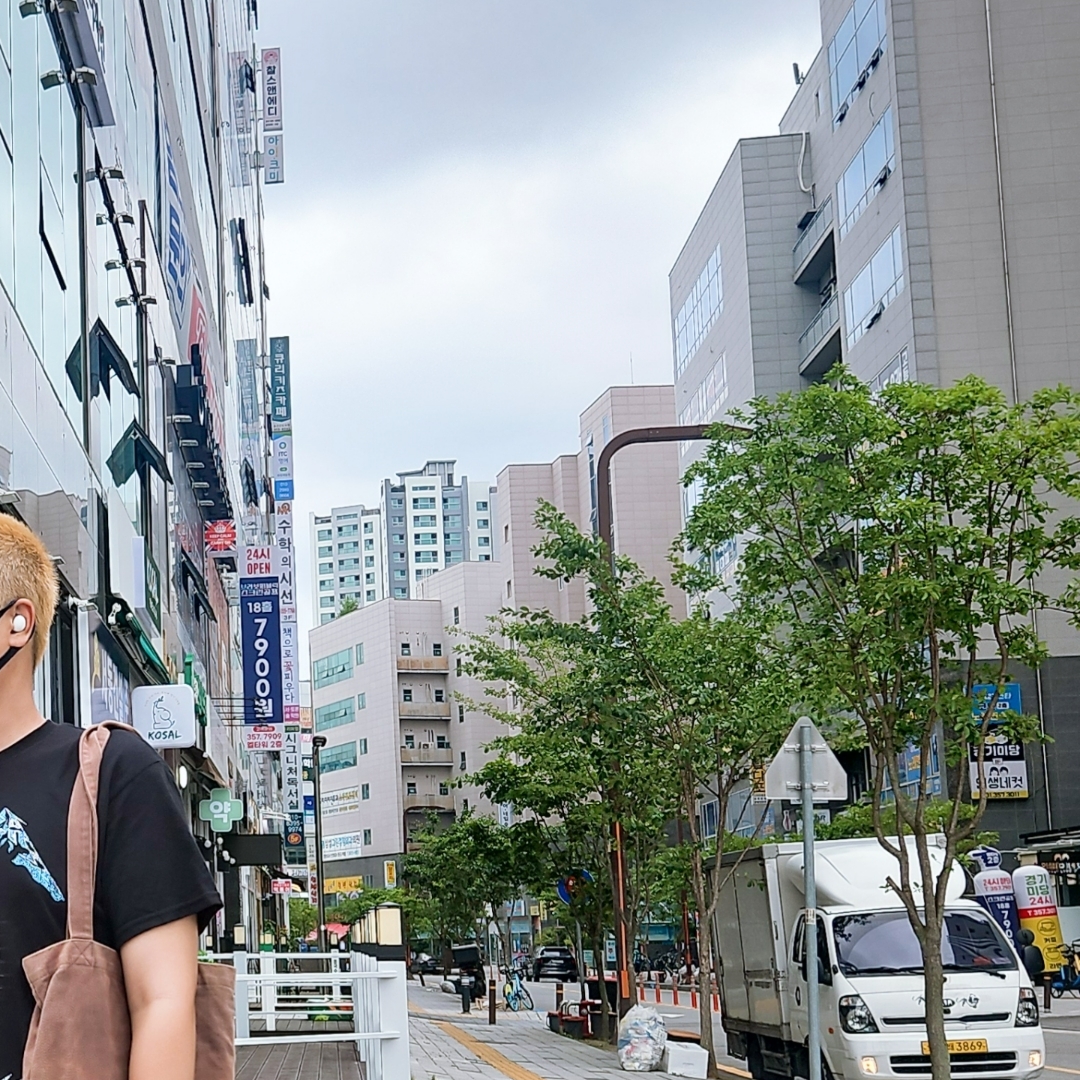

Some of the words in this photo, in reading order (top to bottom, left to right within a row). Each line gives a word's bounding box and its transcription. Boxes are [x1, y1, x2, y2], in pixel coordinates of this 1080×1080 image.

[246, 547, 271, 560] 24시
[247, 562, 271, 575] OPEN
[277, 519, 294, 606] 수학의시선
[247, 601, 273, 613] 18홀
[148, 729, 182, 741] KOSAL
[209, 800, 231, 824] 약
[956, 1041, 982, 1052] 3869
